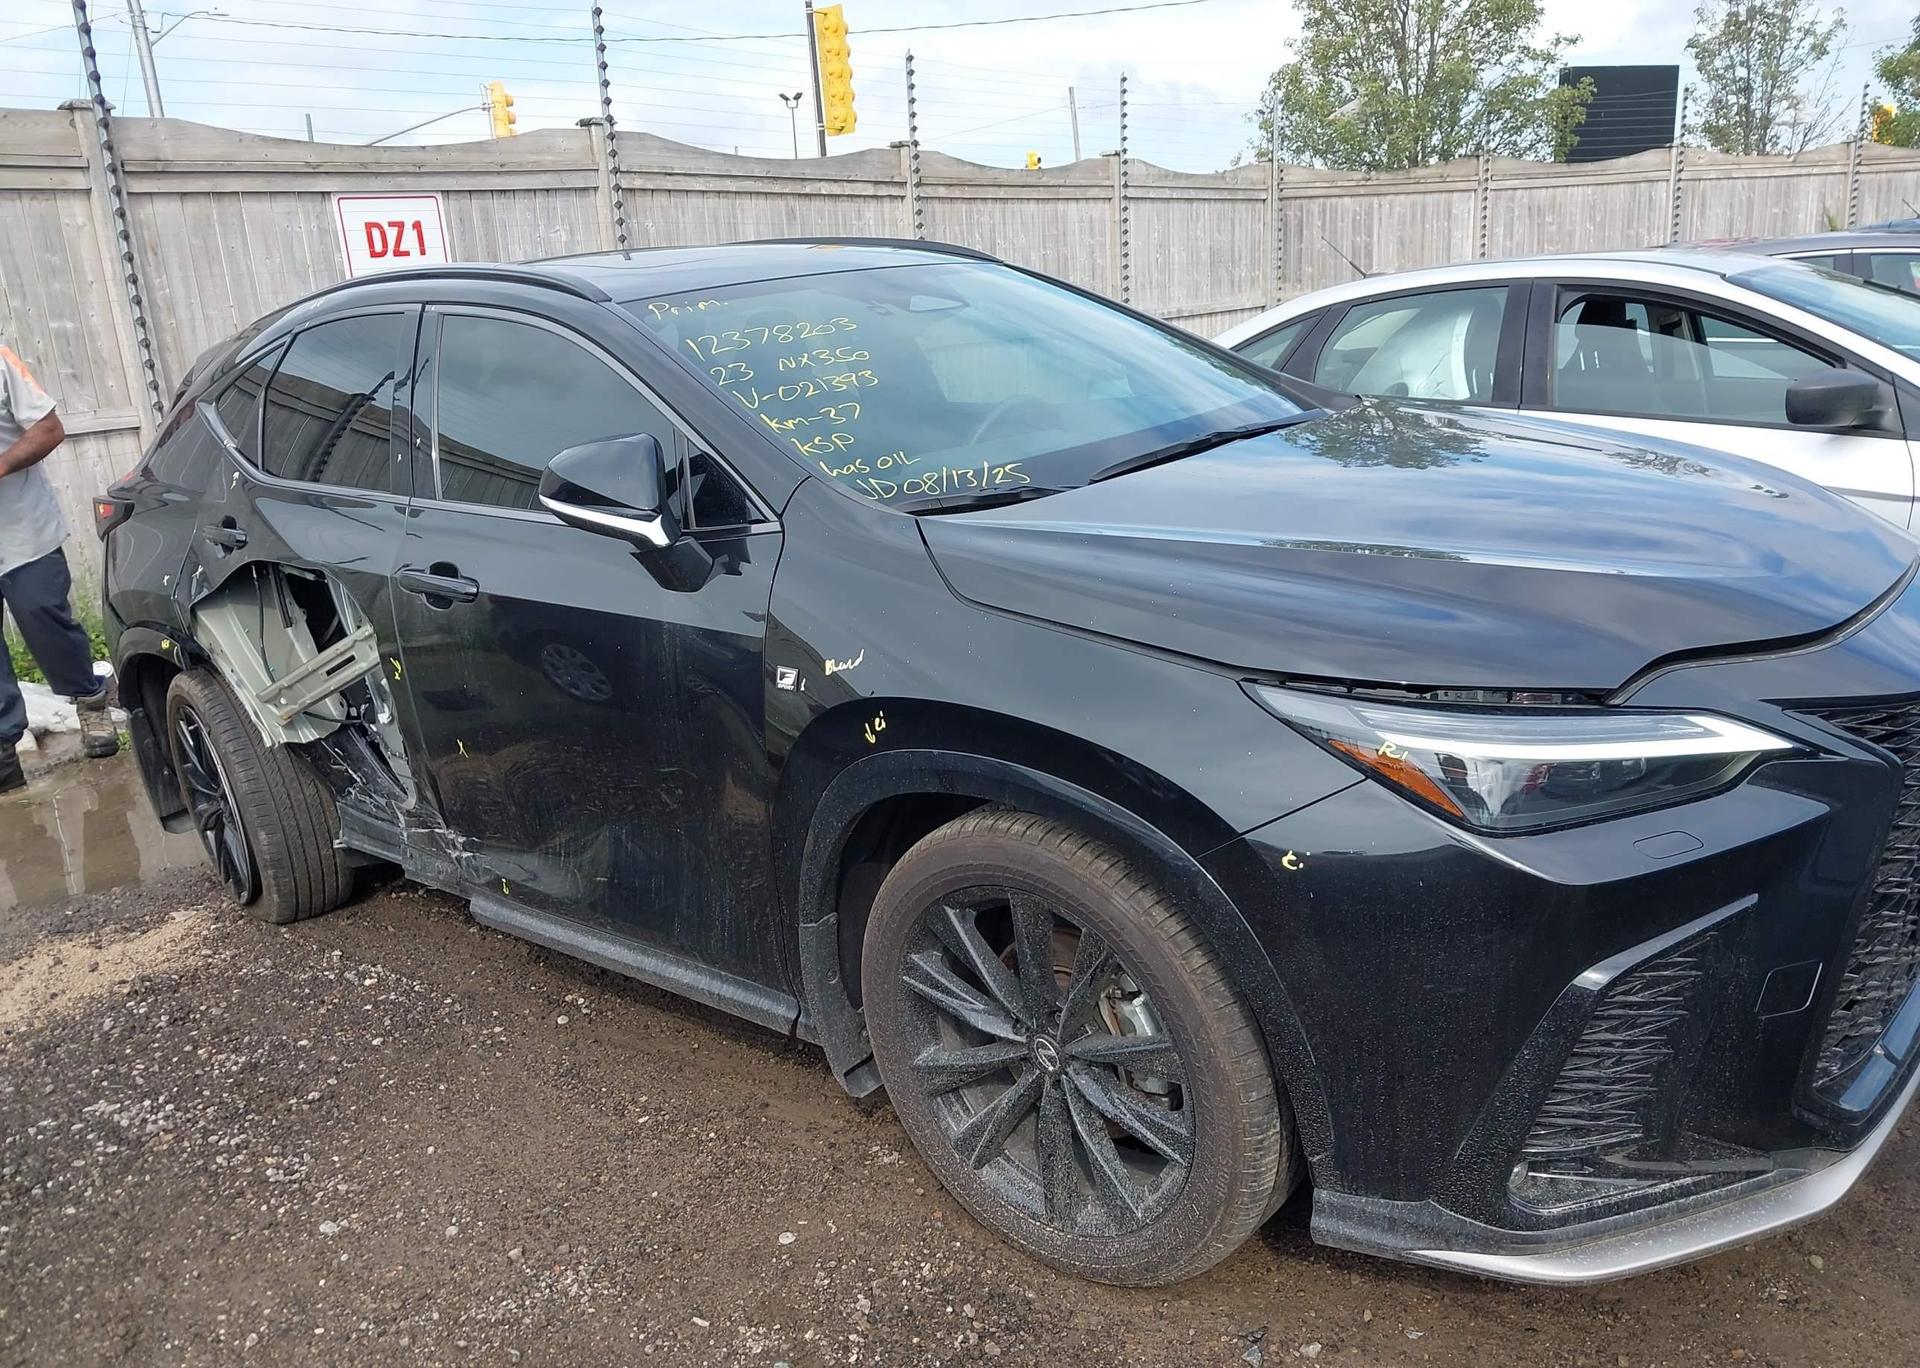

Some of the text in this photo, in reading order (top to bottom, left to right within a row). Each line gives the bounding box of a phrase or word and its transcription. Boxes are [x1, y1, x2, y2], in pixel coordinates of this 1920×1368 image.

[364, 220, 427, 258] DZ1
[685, 317, 857, 362] 12378203
[710, 346, 870, 387] 23 NX350
[903, 460, 1031, 495] 08/13/25
